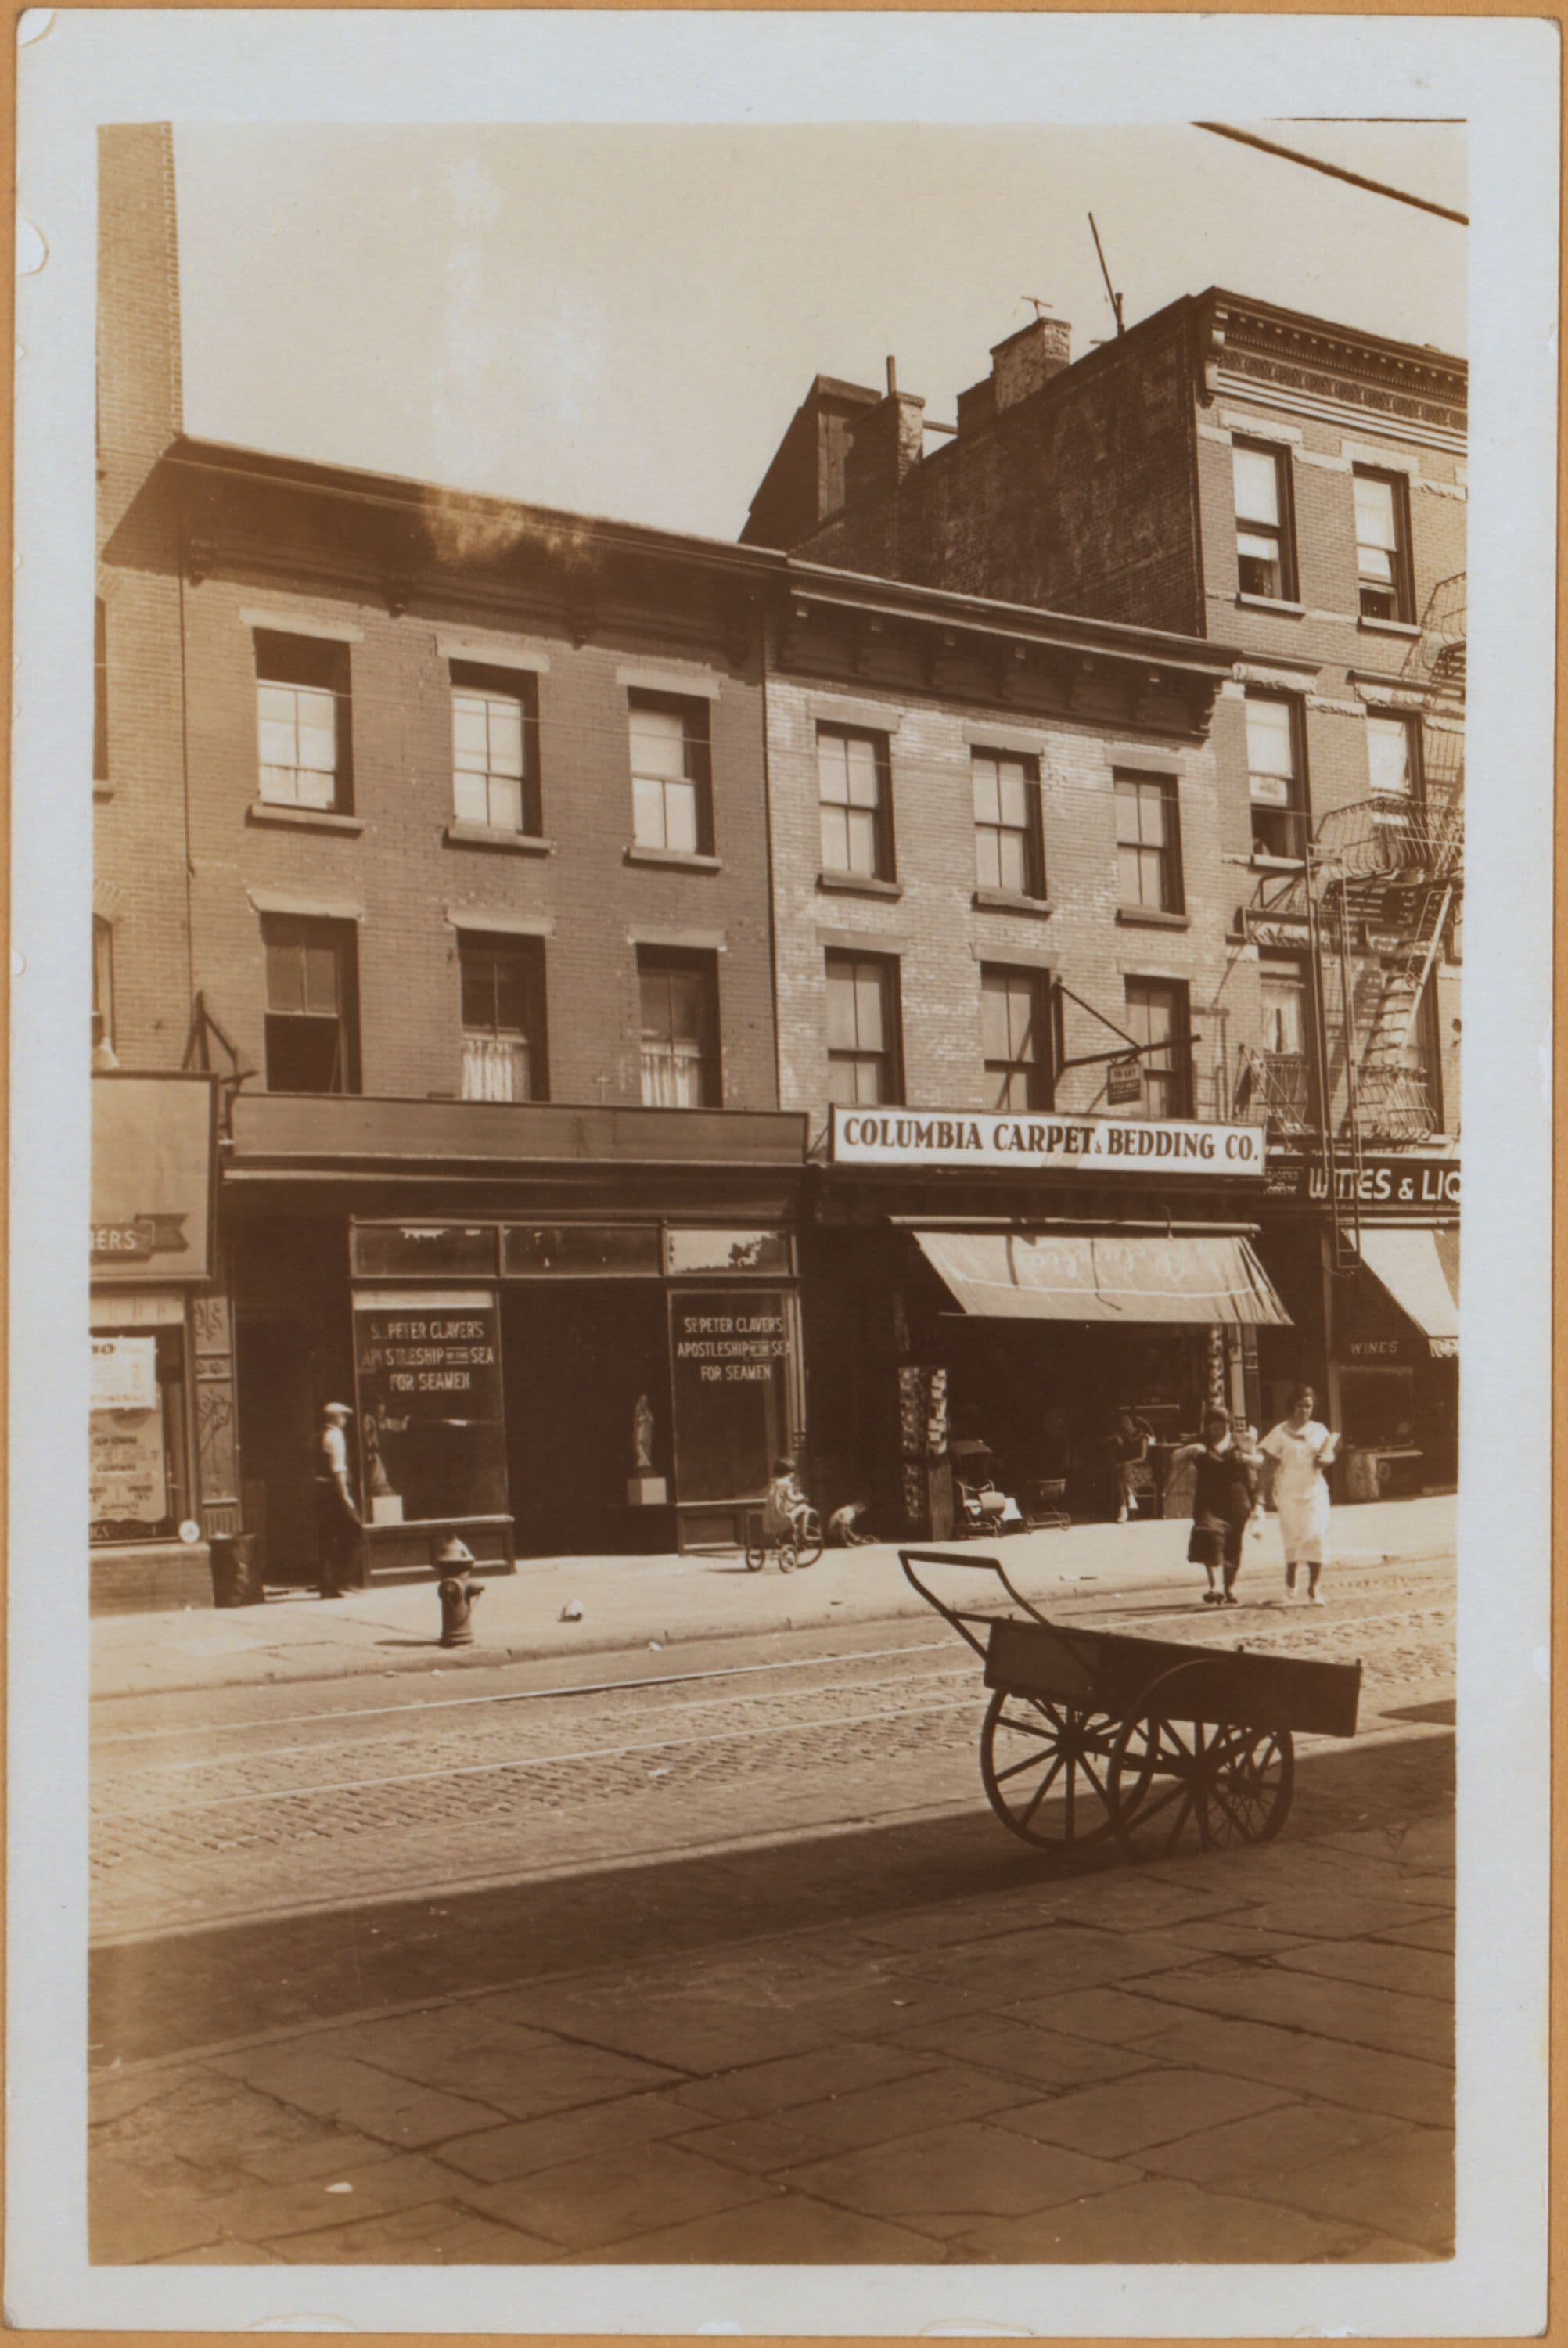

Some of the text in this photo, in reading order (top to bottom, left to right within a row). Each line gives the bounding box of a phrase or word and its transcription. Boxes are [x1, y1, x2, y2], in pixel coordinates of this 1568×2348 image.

[843, 1117, 984, 1150] COLUMBIA
[993, 1123, 1095, 1154] CARPET
[1107, 1127, 1215, 1159] BEDDING
[1225, 1134, 1258, 1161] CO.
[1309, 1167, 1391, 1199] WNES
[1398, 1178, 1413, 1200] &
[388, 1321, 426, 1340] PETER
[699, 1316, 733, 1333] PETER
[361, 1347, 444, 1365] APSTLESHIP
[470, 1346, 494, 1364] SEA
[678, 1340, 749, 1358] APOSTLESHIP
[1350, 1340, 1399, 1355] WINES
[390, 1371, 470, 1390] FOR SEAMEN
[700, 1365, 772, 1382] FOR SEAMEN
